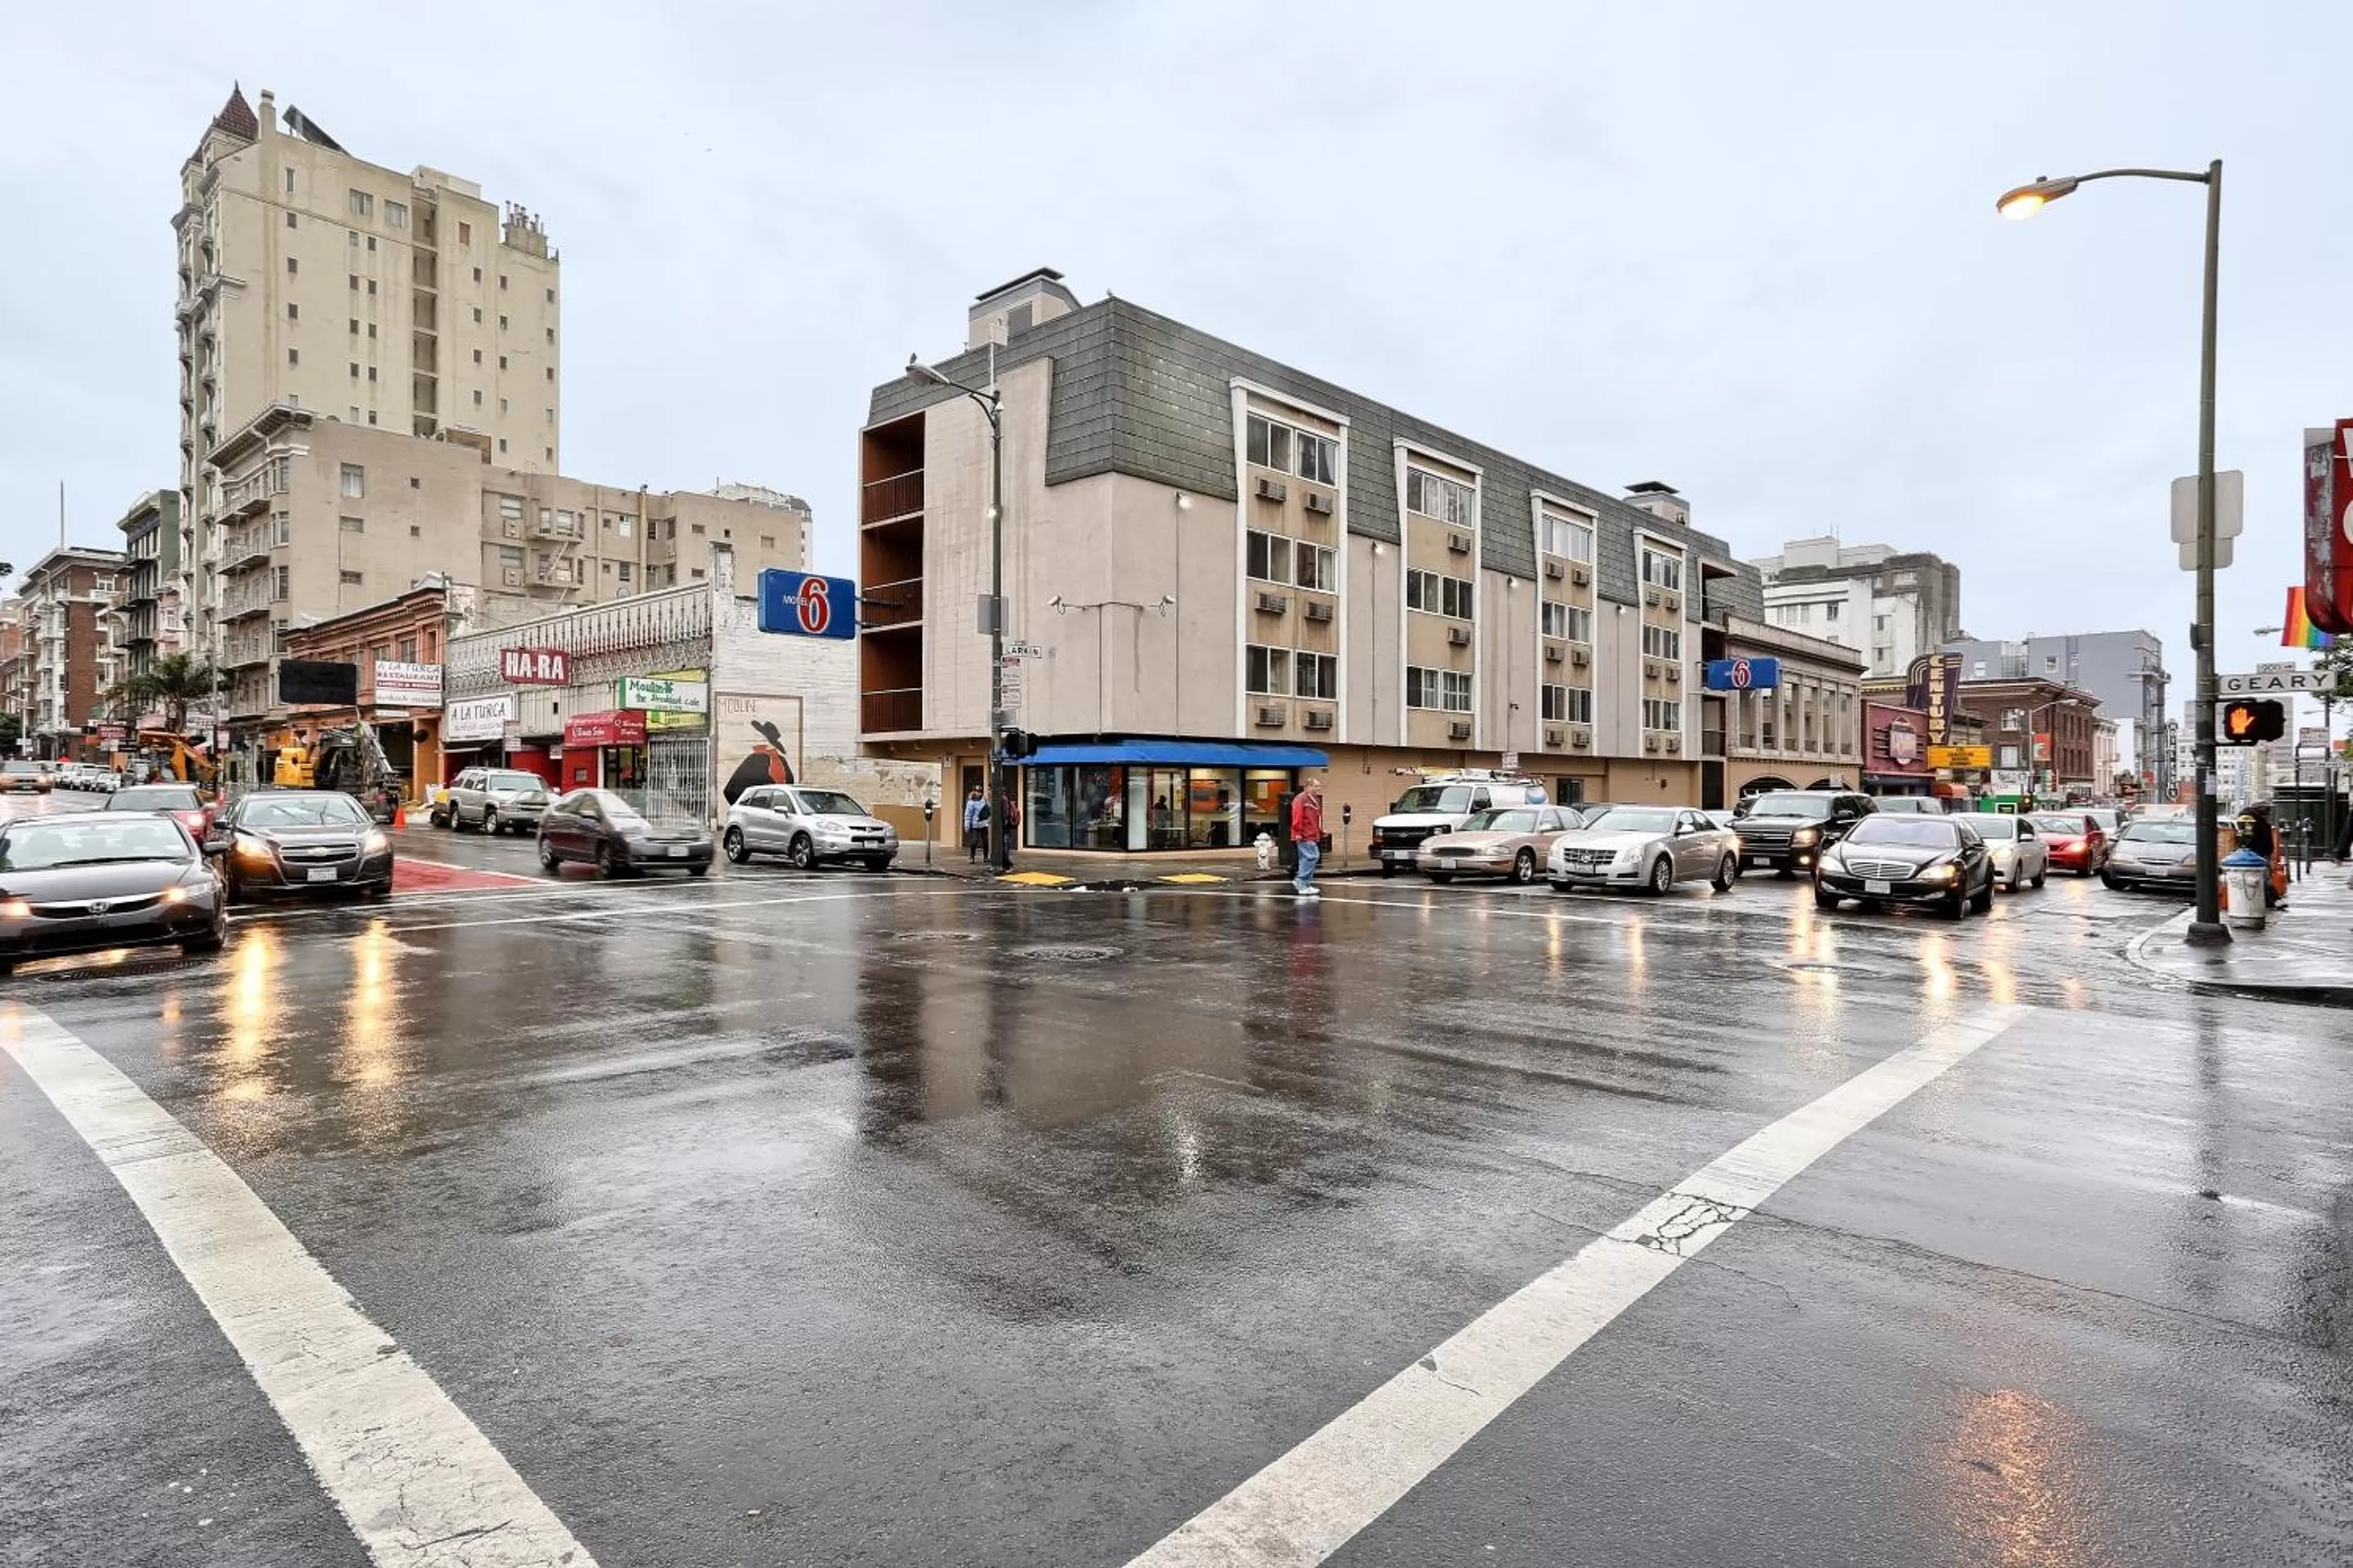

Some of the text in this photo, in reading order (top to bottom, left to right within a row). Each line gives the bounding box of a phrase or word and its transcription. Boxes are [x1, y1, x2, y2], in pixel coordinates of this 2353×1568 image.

[798, 576, 830, 634] 6
[377, 672, 439, 681] RESTAURANT
[506, 652, 564, 680] HA-RA
[1731, 659, 1751, 688] 6
[2227, 674, 2328, 690] GEARY
[452, 702, 505, 721] A LA TURCA
[1928, 654, 1945, 744] CENTURY
